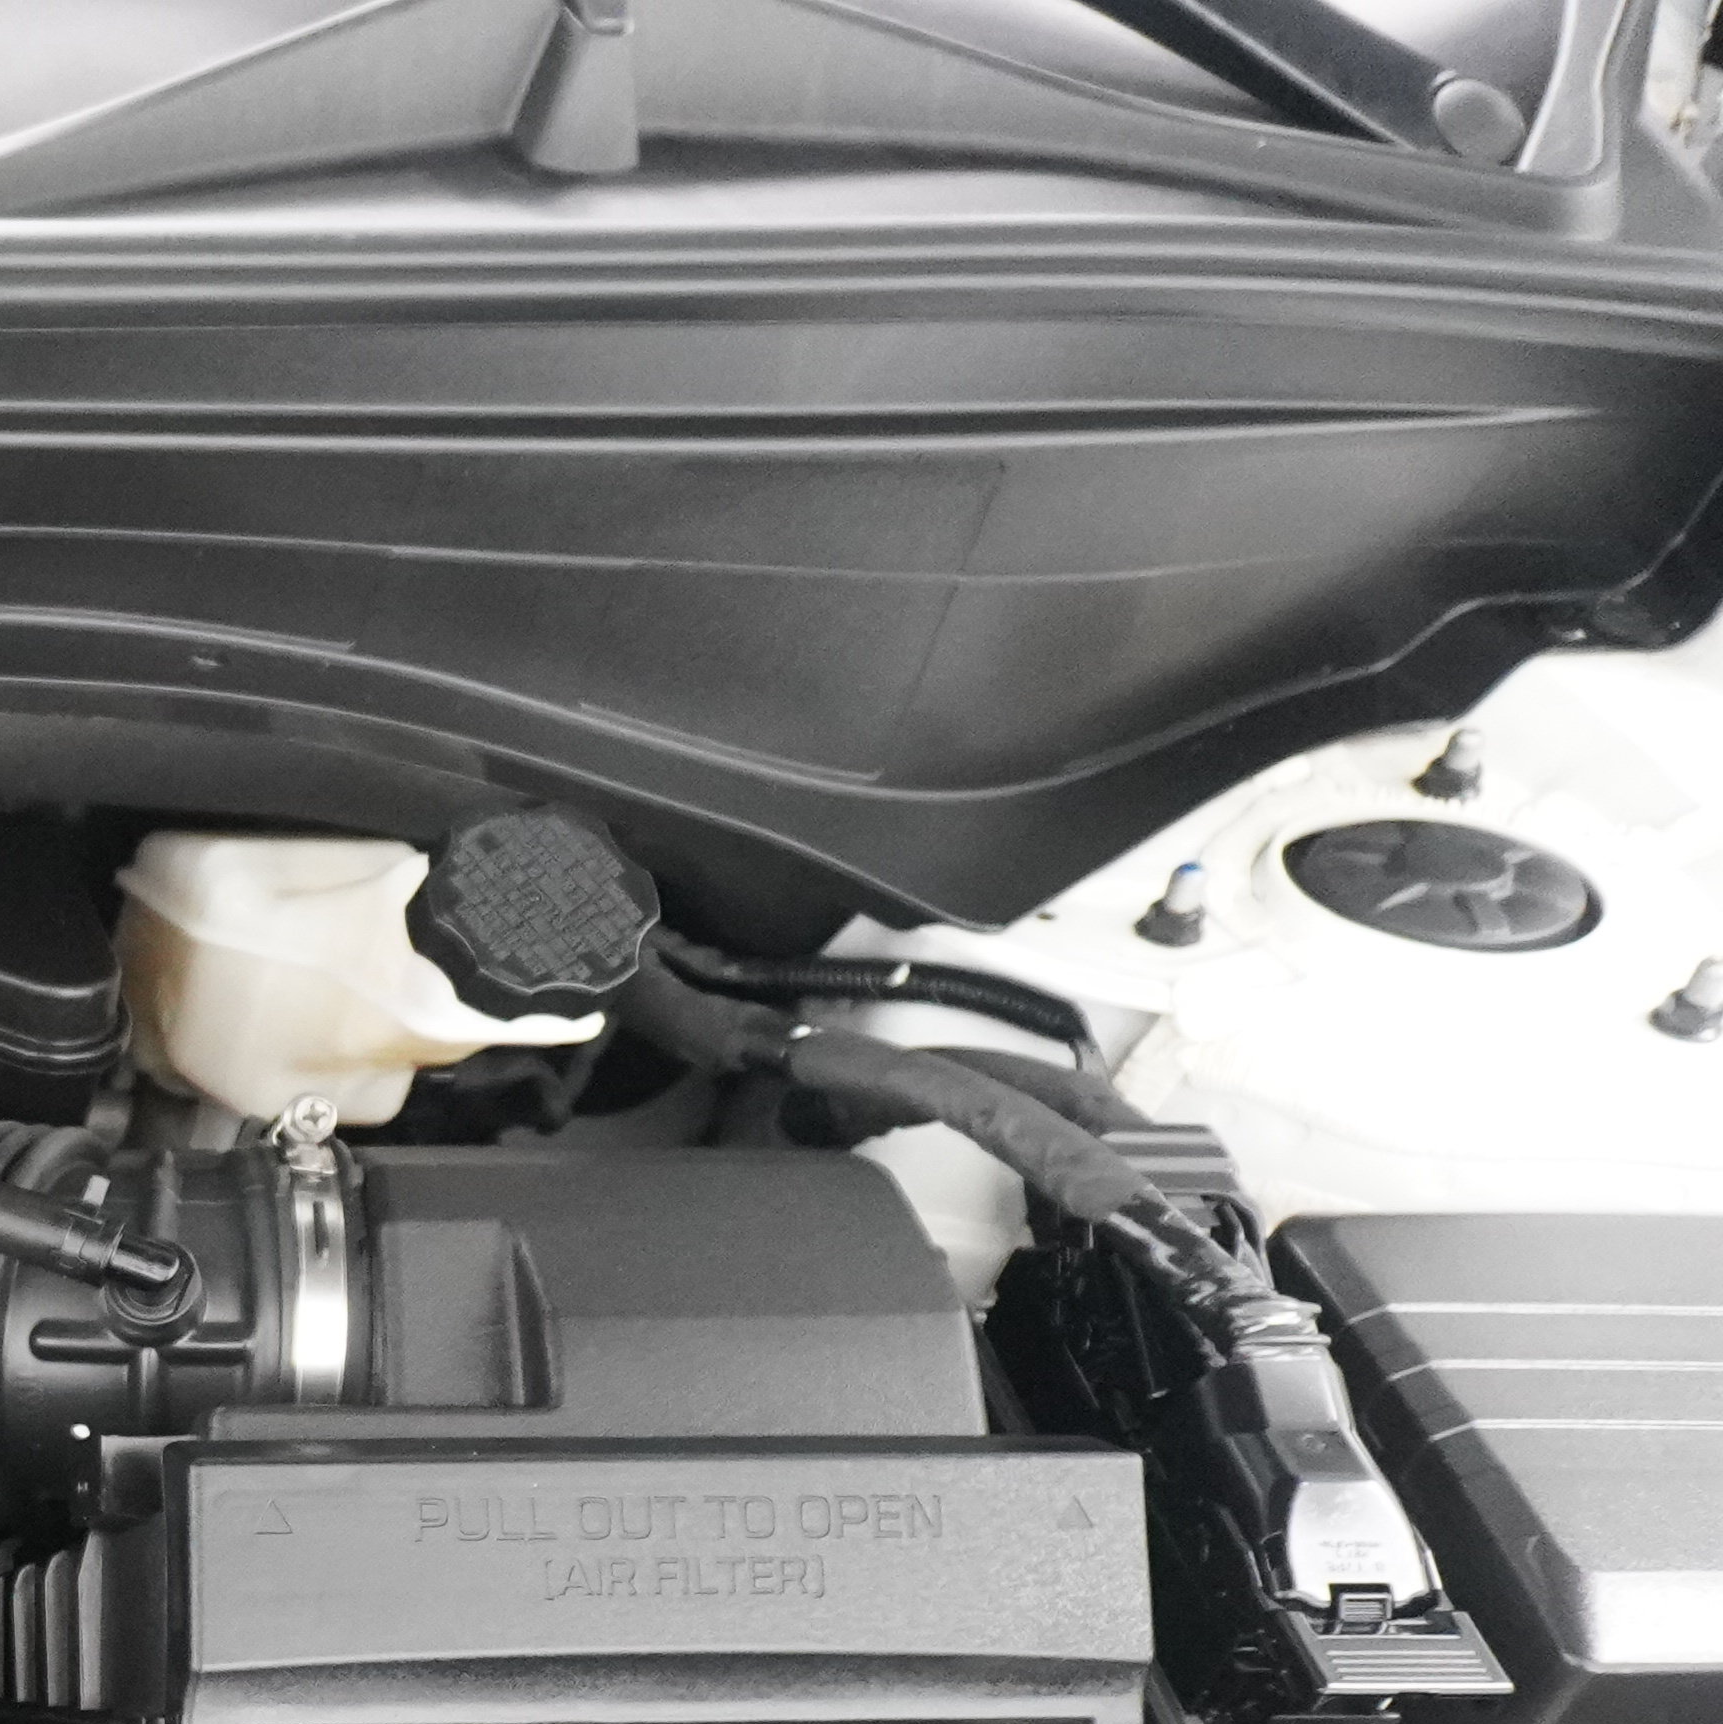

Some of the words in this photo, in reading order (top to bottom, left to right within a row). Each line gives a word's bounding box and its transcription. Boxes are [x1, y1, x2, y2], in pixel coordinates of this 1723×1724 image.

[414, 1497, 558, 1542] PULL
[578, 1496, 686, 1541] OUT
[704, 1495, 775, 1540] TO
[798, 1494, 944, 1540] OPEN
